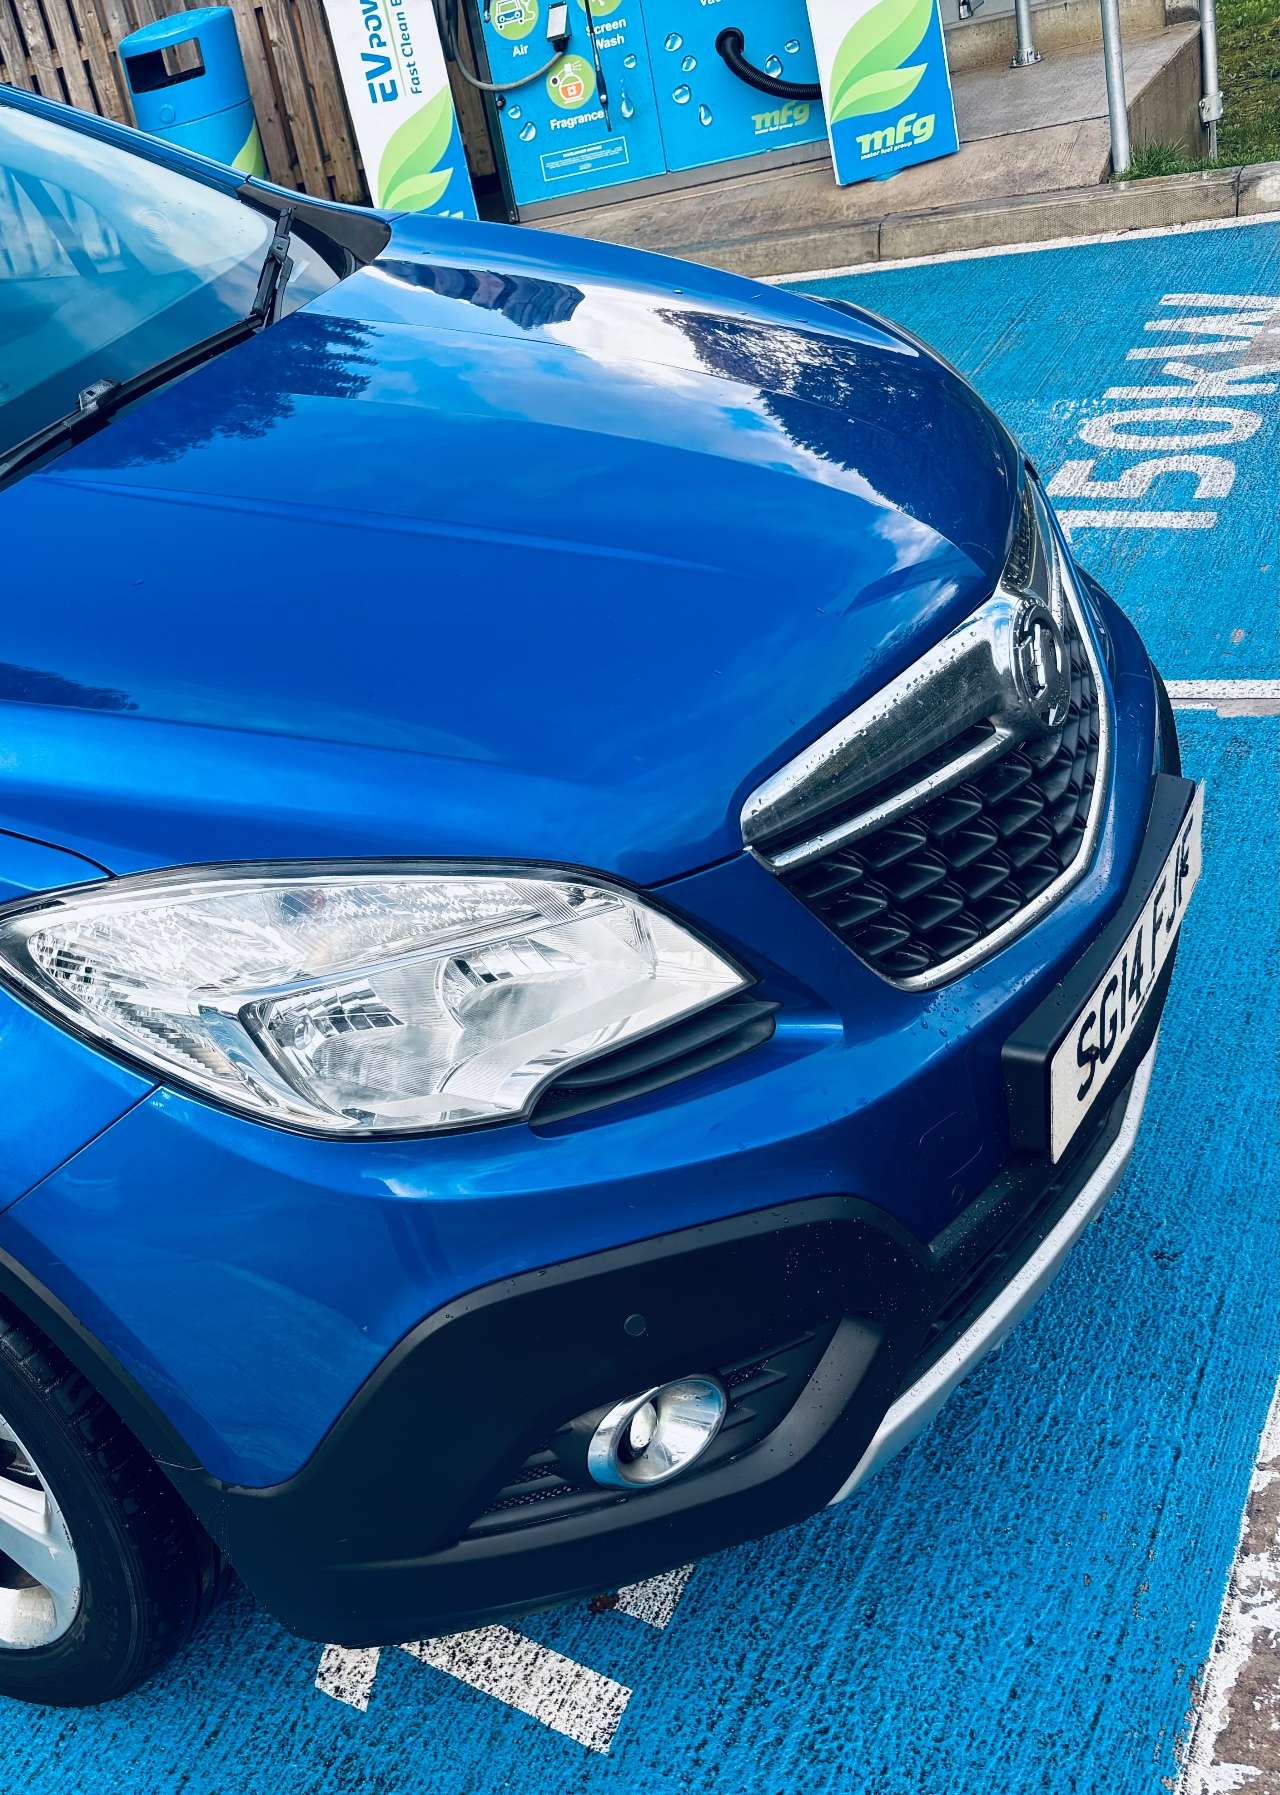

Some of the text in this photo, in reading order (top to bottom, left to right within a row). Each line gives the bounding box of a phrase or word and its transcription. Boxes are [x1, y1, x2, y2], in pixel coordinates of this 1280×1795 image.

[359, 0, 398, 104] EV POW
[396, 12, 414, 57] Clean
[512, 43, 529, 58] Air
[406, 60, 422, 94] Fast
[549, 111, 605, 131] Fragrance
[751, 101, 810, 130] mfg
[855, 112, 936, 154] mfg
[1076, 924, 1144, 1101] SG14
